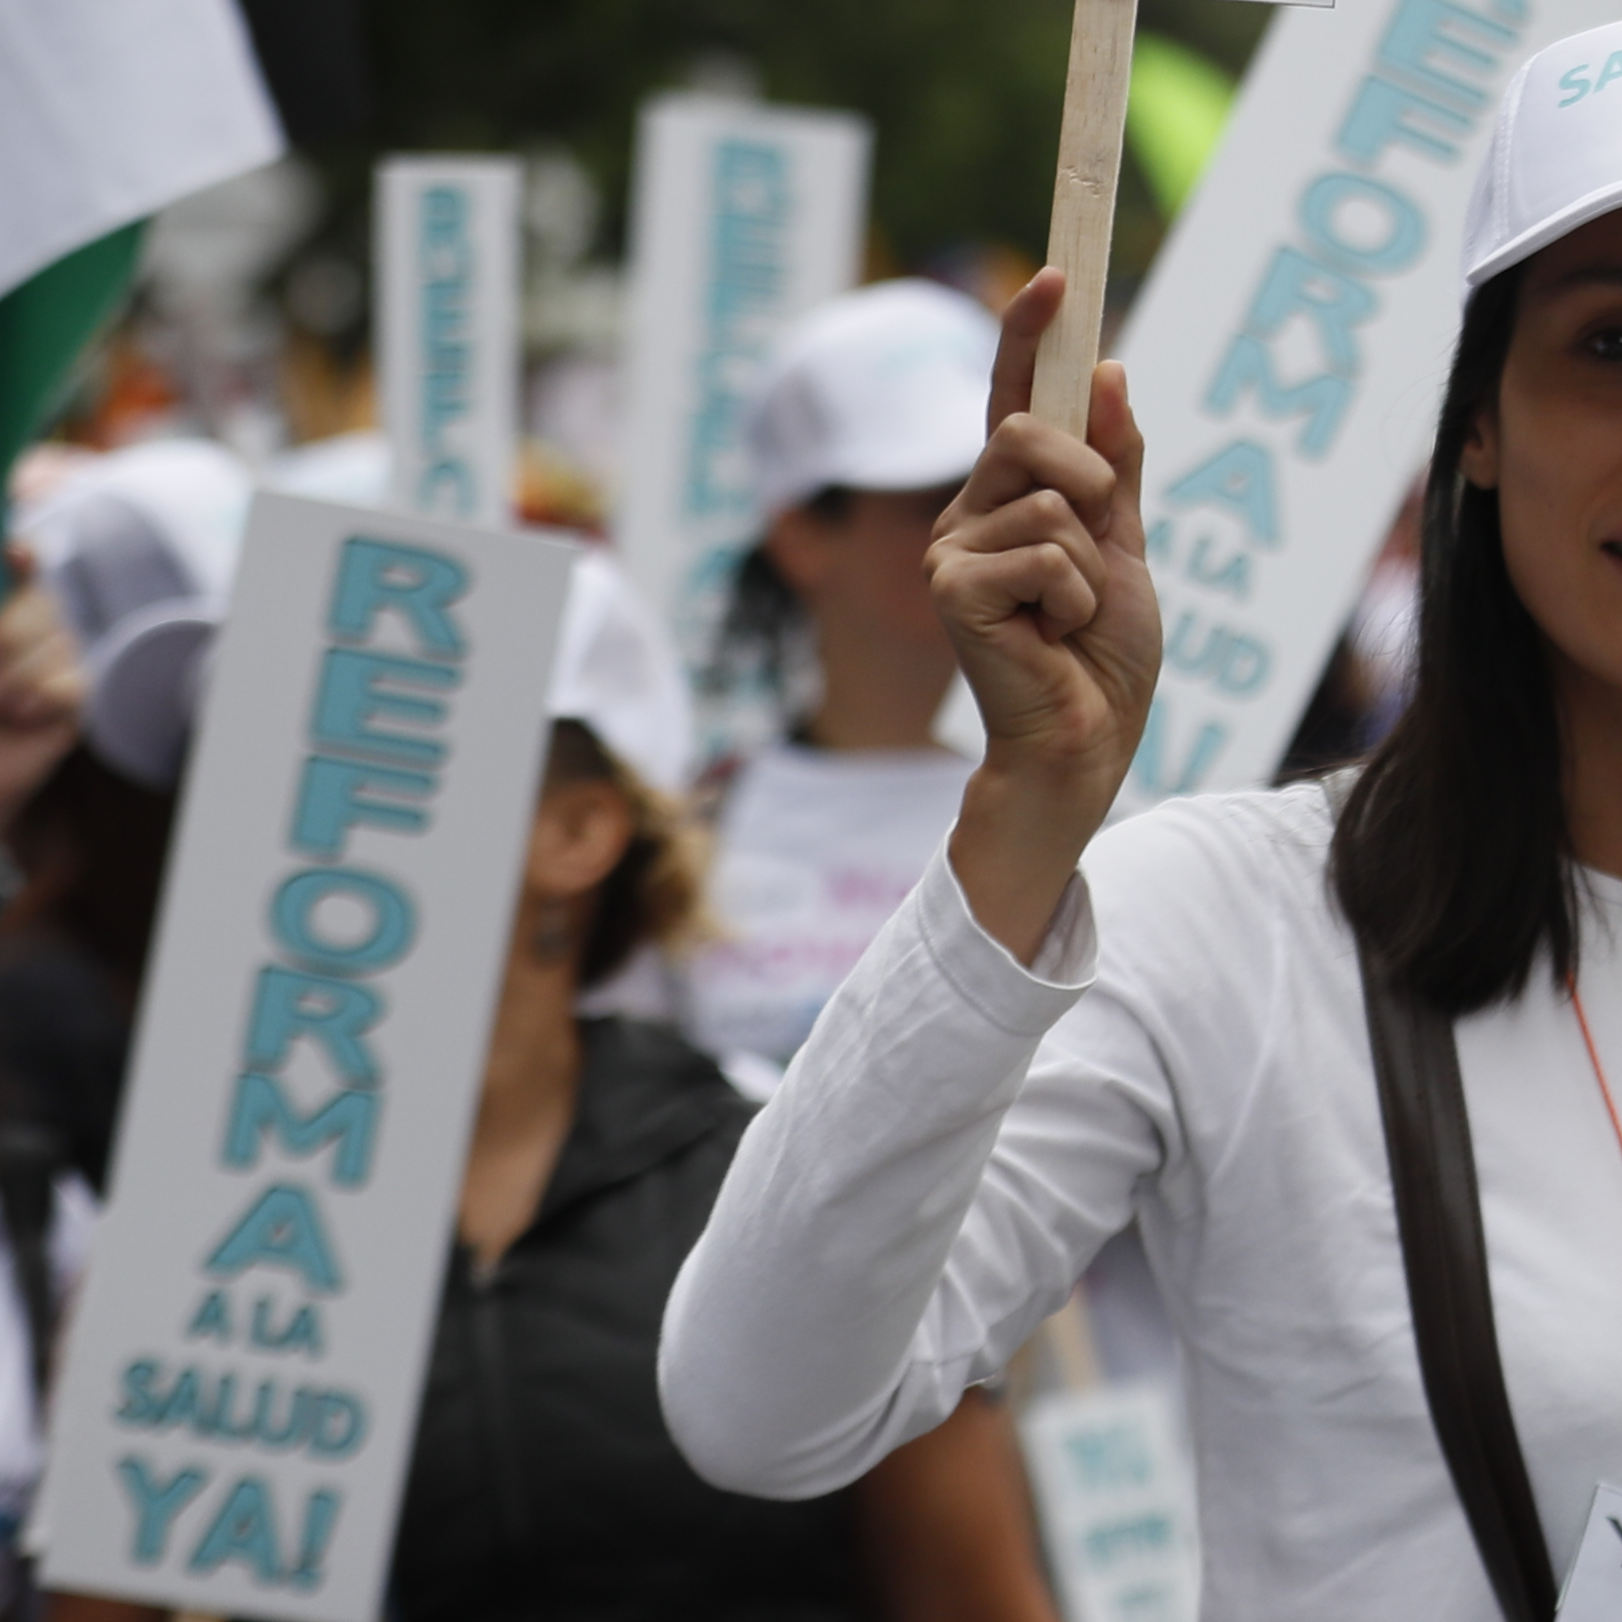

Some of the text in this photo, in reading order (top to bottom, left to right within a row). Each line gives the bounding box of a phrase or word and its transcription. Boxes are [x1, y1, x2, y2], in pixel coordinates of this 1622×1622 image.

[203, 533, 469, 1295] REFORMA
[186, 1288, 327, 1357] A LA
[110, 1357, 371, 1461] SALUD
[115, 1454, 345, 1591] YA!
